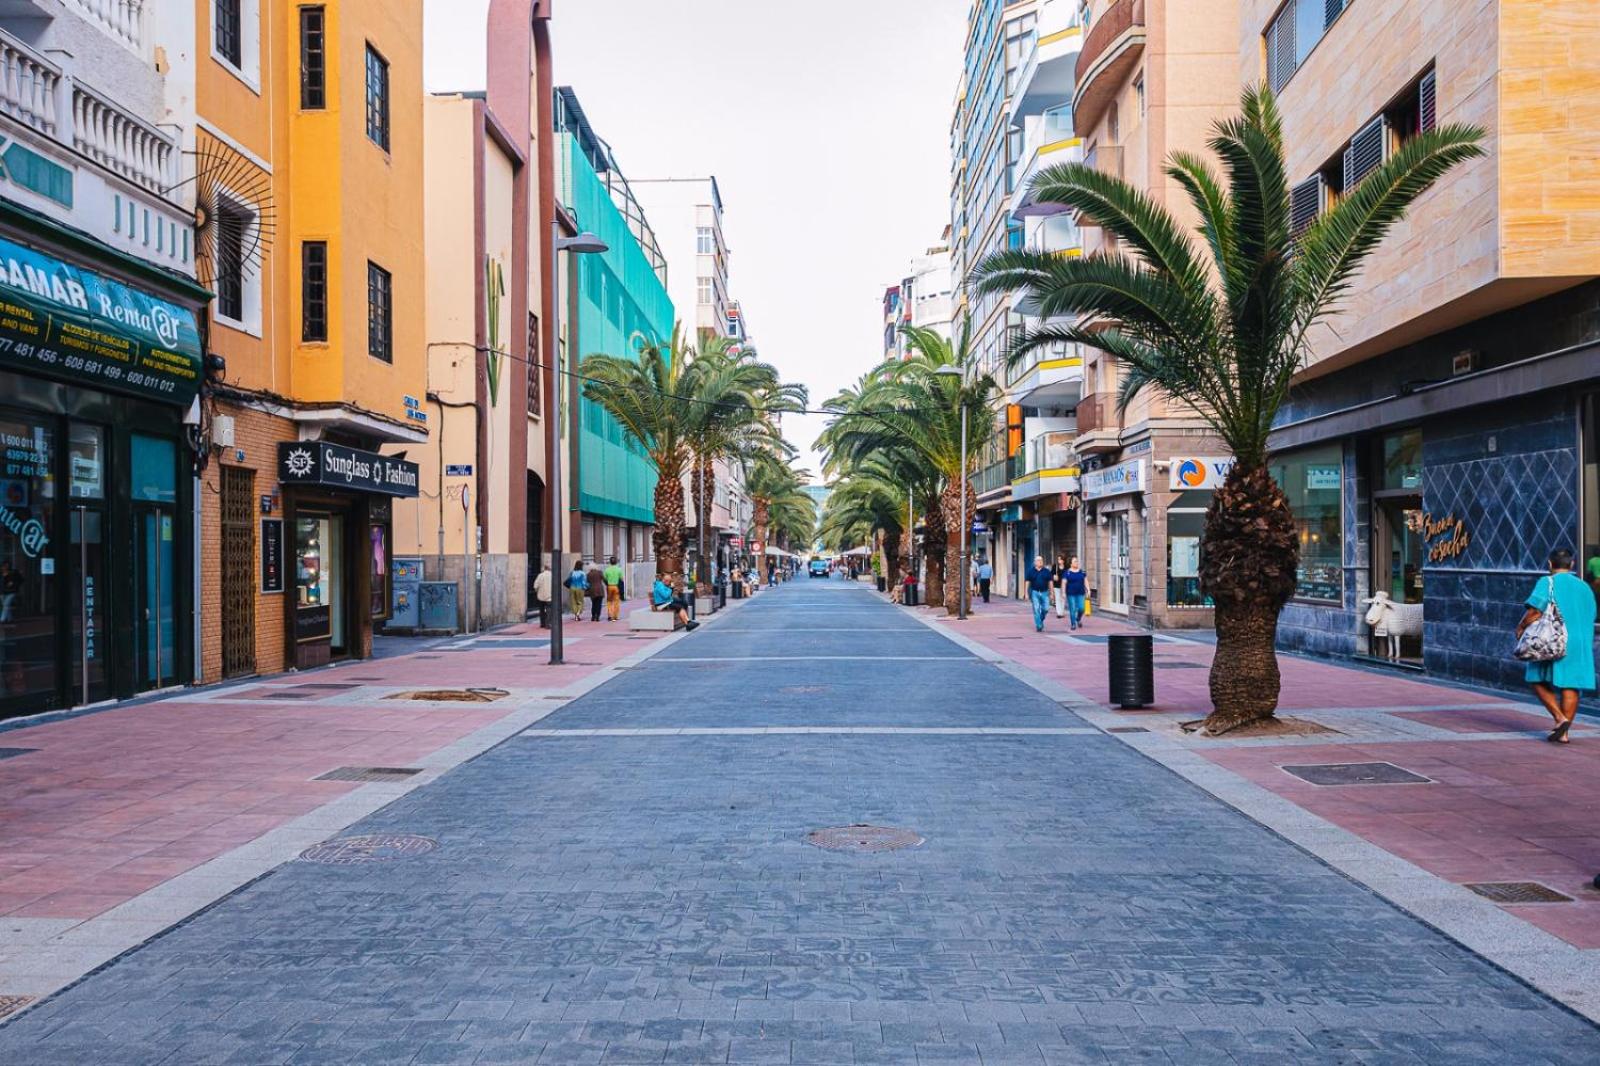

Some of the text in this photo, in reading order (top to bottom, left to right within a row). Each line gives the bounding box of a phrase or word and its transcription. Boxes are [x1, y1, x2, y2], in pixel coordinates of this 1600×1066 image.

[14, 343, 35, 358] 481
[37, 349, 58, 363] 456
[65, 355, 84, 369] 608
[84, 360, 102, 374] 681
[104, 366, 121, 379] 499
[127, 371, 143, 384] 600
[144, 376, 159, 388] 011
[160, 380, 175, 392] 012
[293, 457, 307, 468] SF
[325, 449, 370, 482] Sunglass
[386, 462, 416, 487] Fashion
[86, 576, 94, 657] RENTACAR
